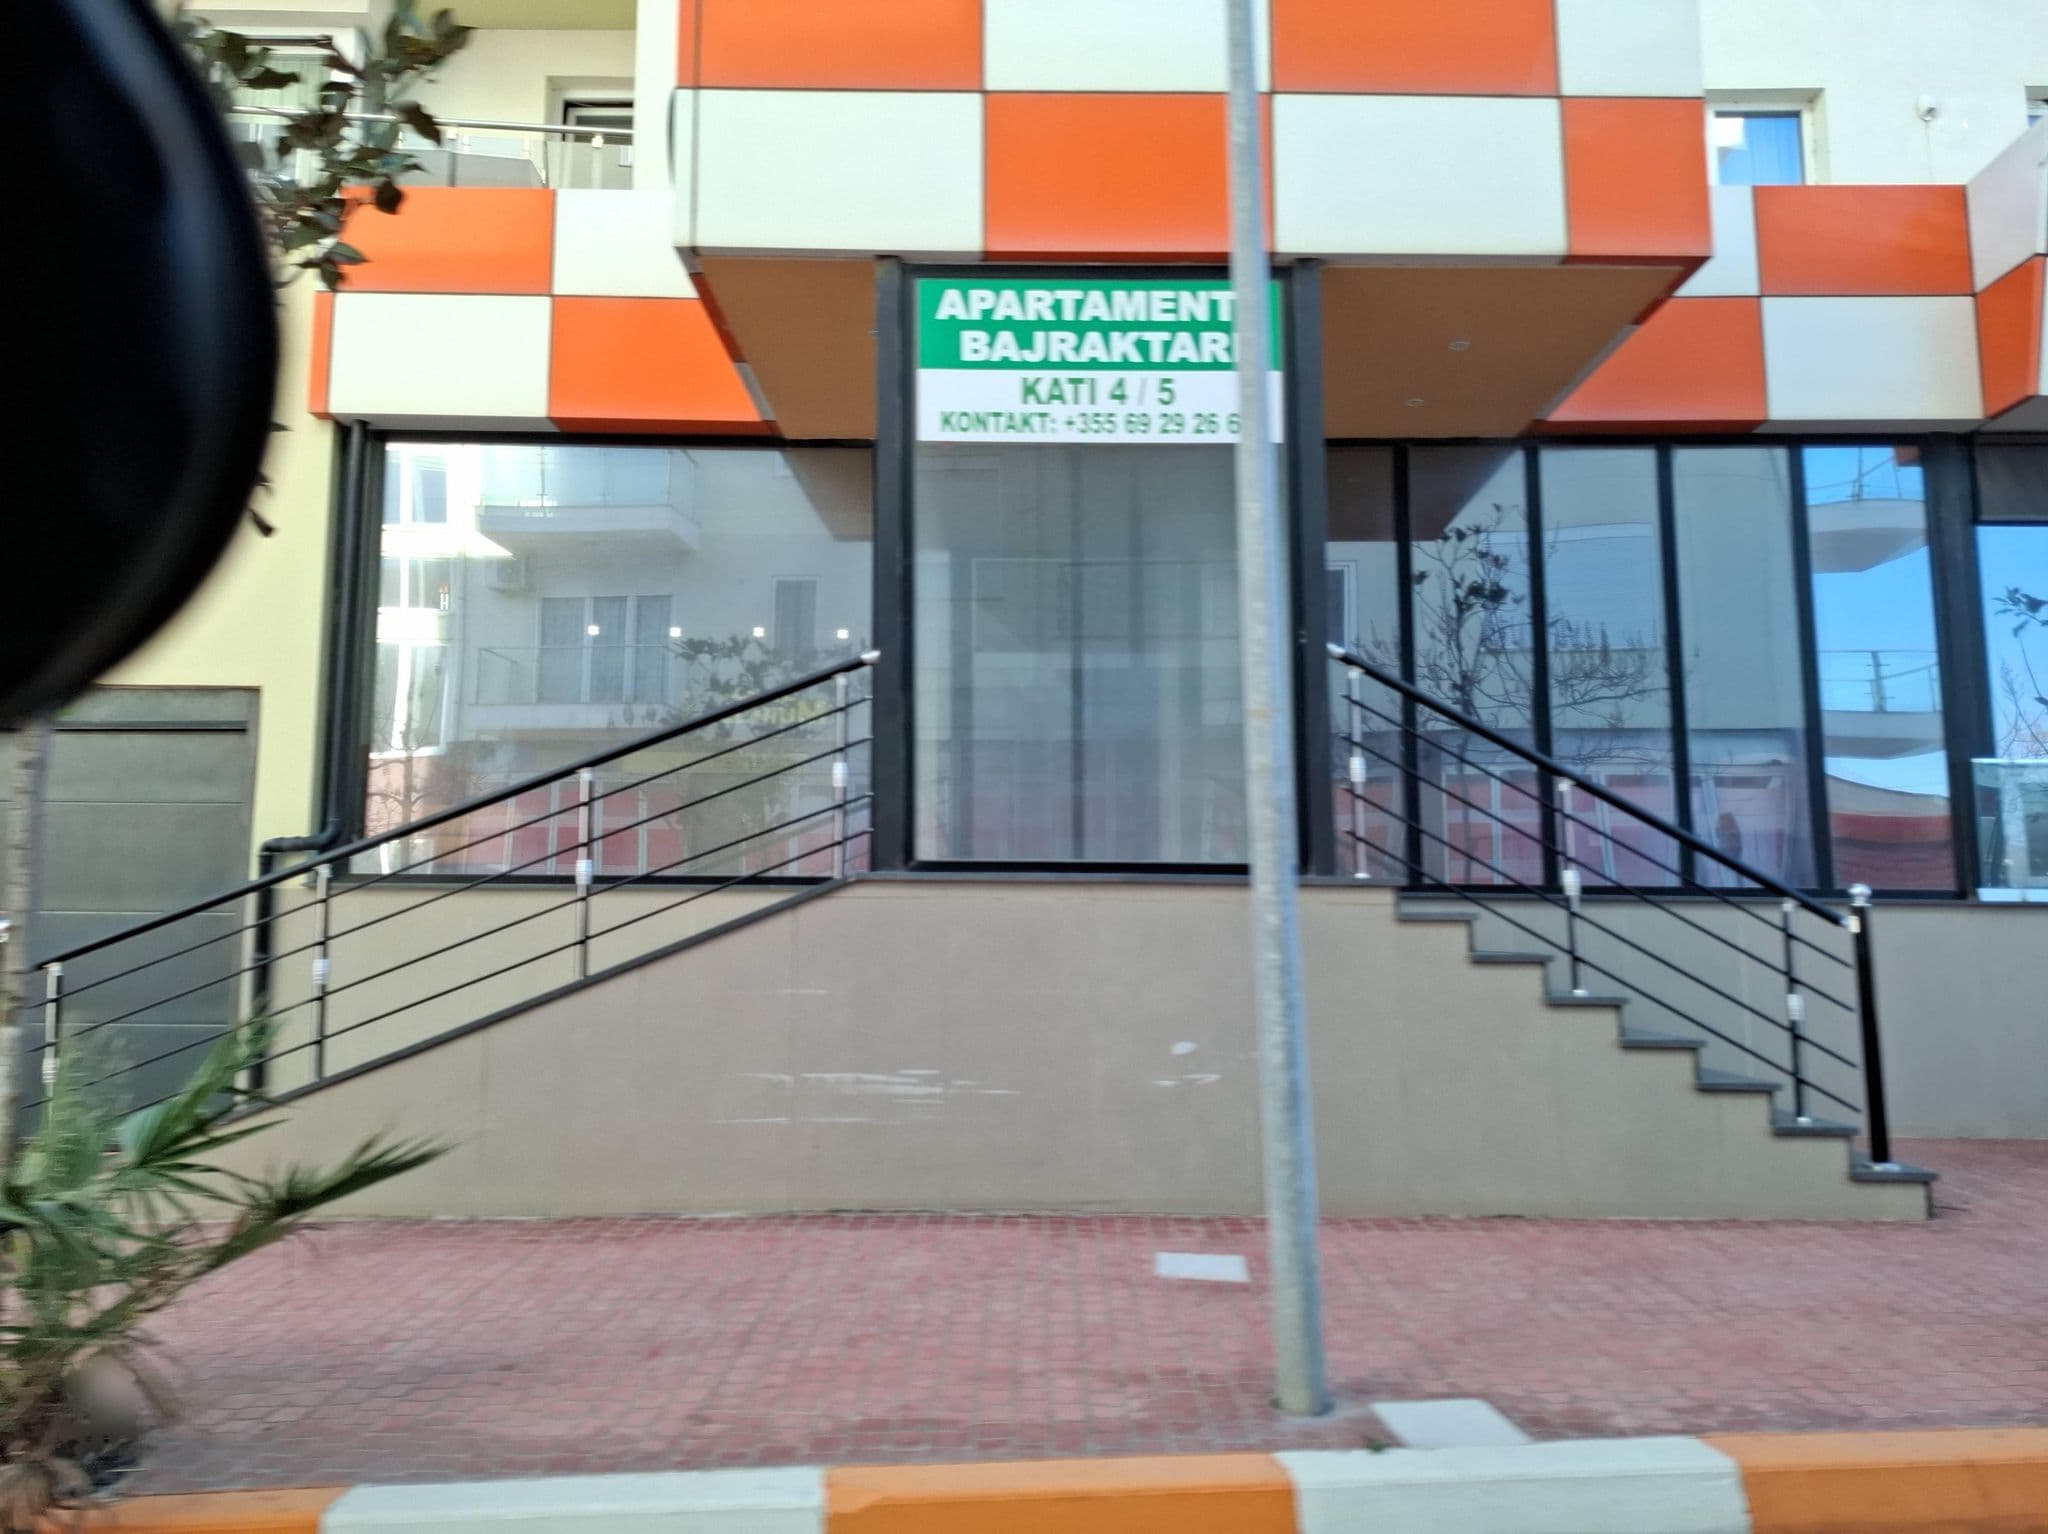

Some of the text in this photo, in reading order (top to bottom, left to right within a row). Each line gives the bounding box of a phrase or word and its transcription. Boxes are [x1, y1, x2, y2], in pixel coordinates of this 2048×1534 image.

[935, 289, 1241, 322] APARTAMENT
[1020, 377, 1097, 405] KATI
[1109, 377, 1128, 405] 4
[1157, 378, 1176, 406] 5
[939, 411, 1241, 434] KONTAKT: +355 69 29 26 6
